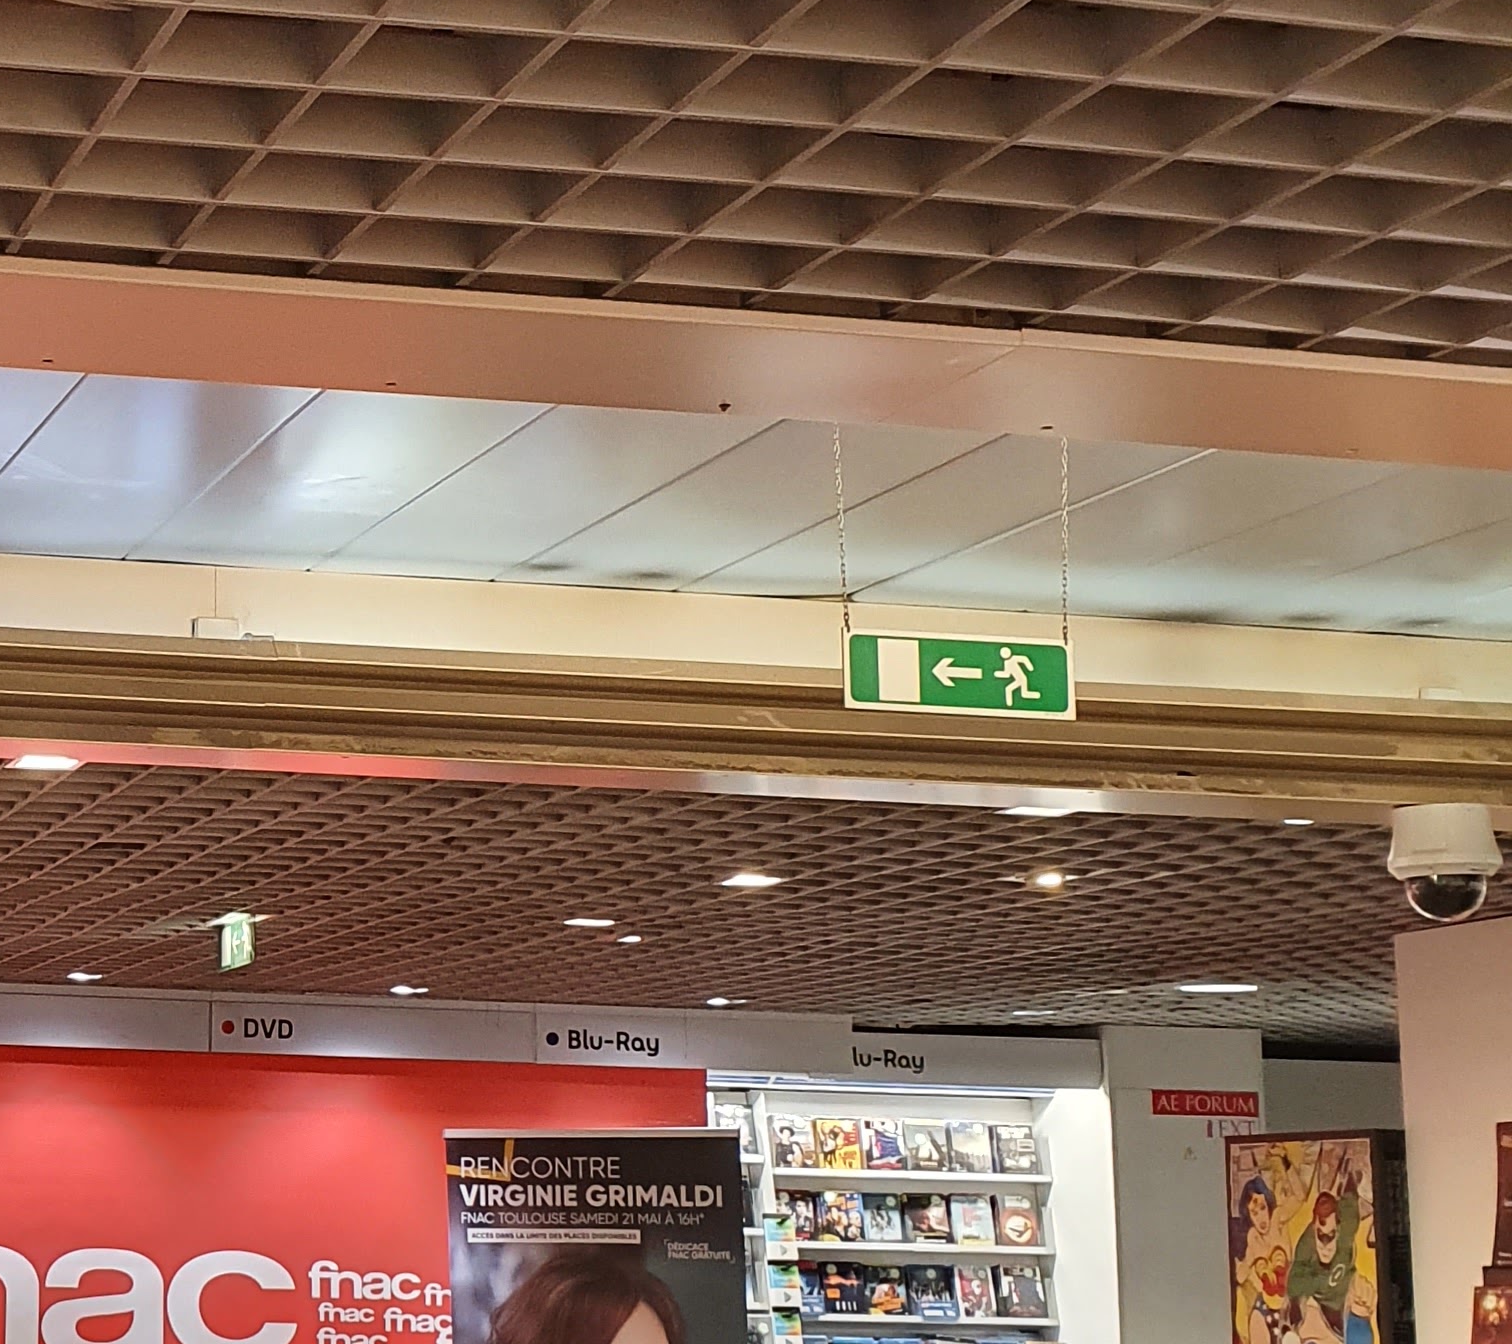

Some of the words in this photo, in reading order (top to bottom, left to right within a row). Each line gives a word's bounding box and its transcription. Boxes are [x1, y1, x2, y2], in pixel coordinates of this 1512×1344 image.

[243, 1017, 294, 1040] DVD
[568, 1029, 660, 1057] Blu-Ray
[852, 1046, 925, 1074] lu-Ray
[1186, 1094, 1255, 1113] FORUM
[460, 1156, 621, 1180] RENCONTRE
[459, 1183, 577, 1208] VIRGINIE
[585, 1184, 723, 1208] GRIMALDI
[460, 1211, 495, 1225] FNAC
[497, 1211, 567, 1225] TOULOUSE
[570, 1212, 619, 1225] SAMEDI
[622, 1212, 634, 1225] 21
[638, 1213, 662, 1225] MAI
[308, 1260, 421, 1301] fnac
[318, 1302, 375, 1323] fnac
